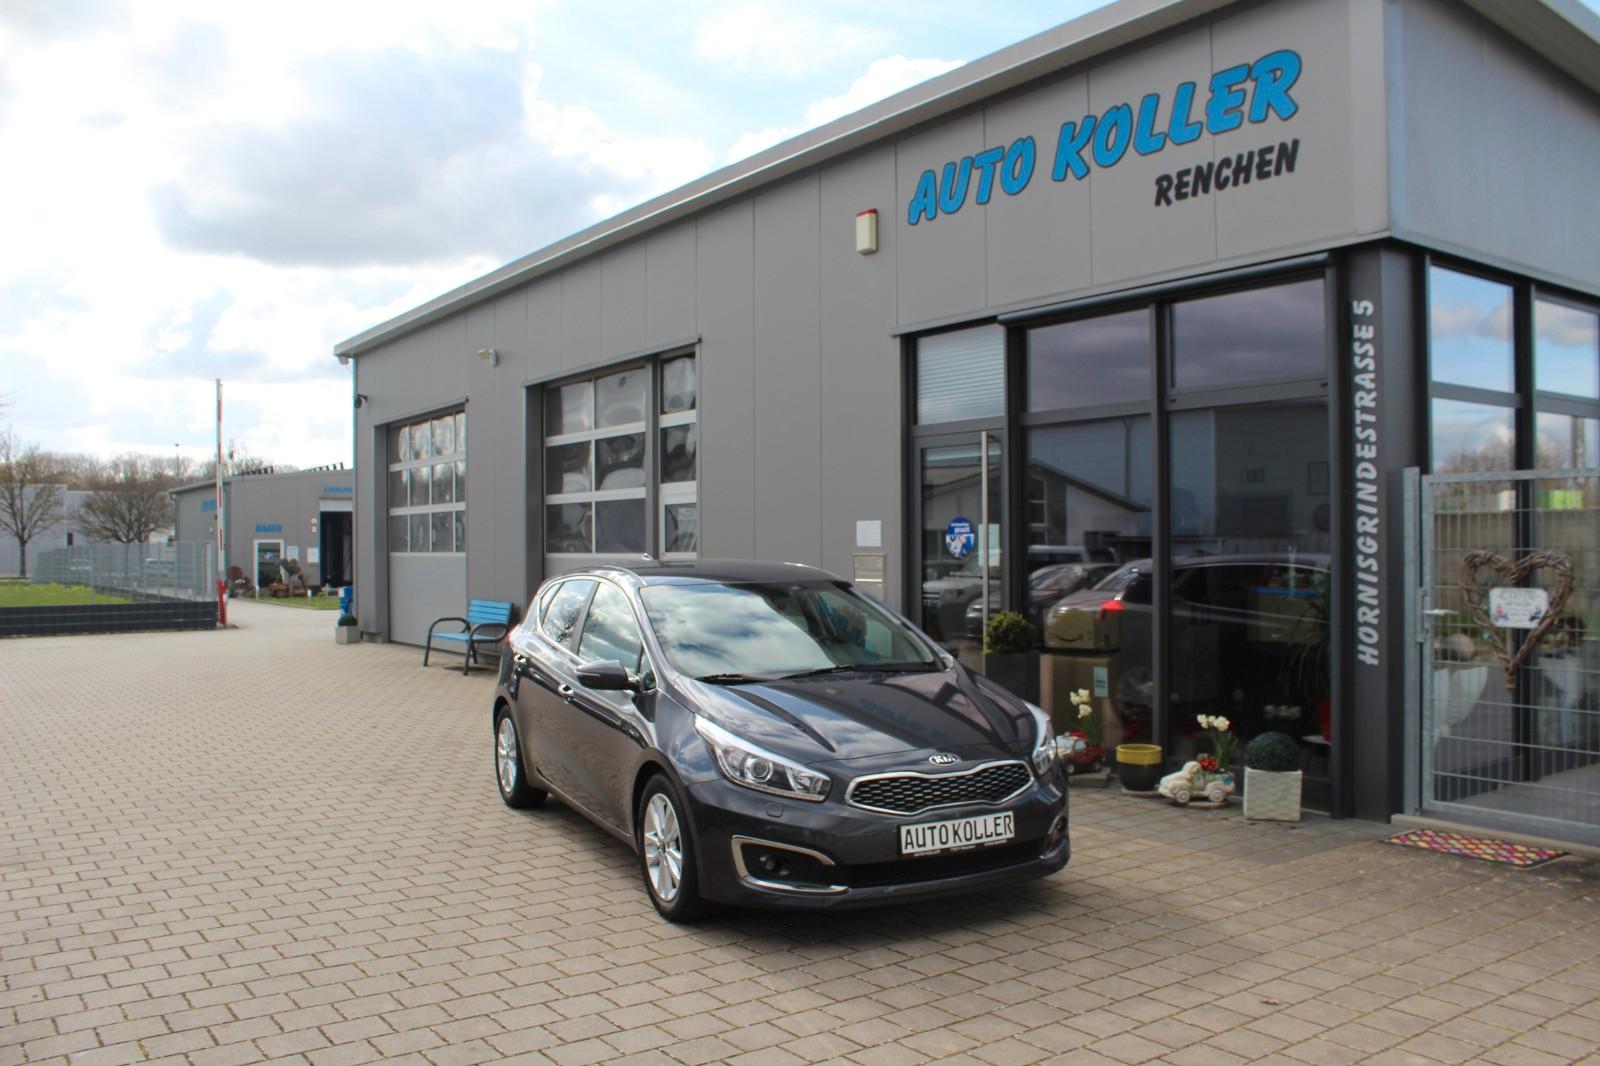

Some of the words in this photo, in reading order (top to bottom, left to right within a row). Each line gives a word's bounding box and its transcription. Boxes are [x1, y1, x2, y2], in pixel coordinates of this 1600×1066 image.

[908, 136, 1036, 226] AUTO
[1051, 49, 1302, 182] KOLLER
[1154, 139, 1300, 207] RENCHEN
[1353, 299, 1375, 317] 5
[1353, 326, 1380, 666] HORNISGRINDESTRASSE
[904, 824, 949, 850] AUTO
[953, 815, 1013, 843] KOLLER
